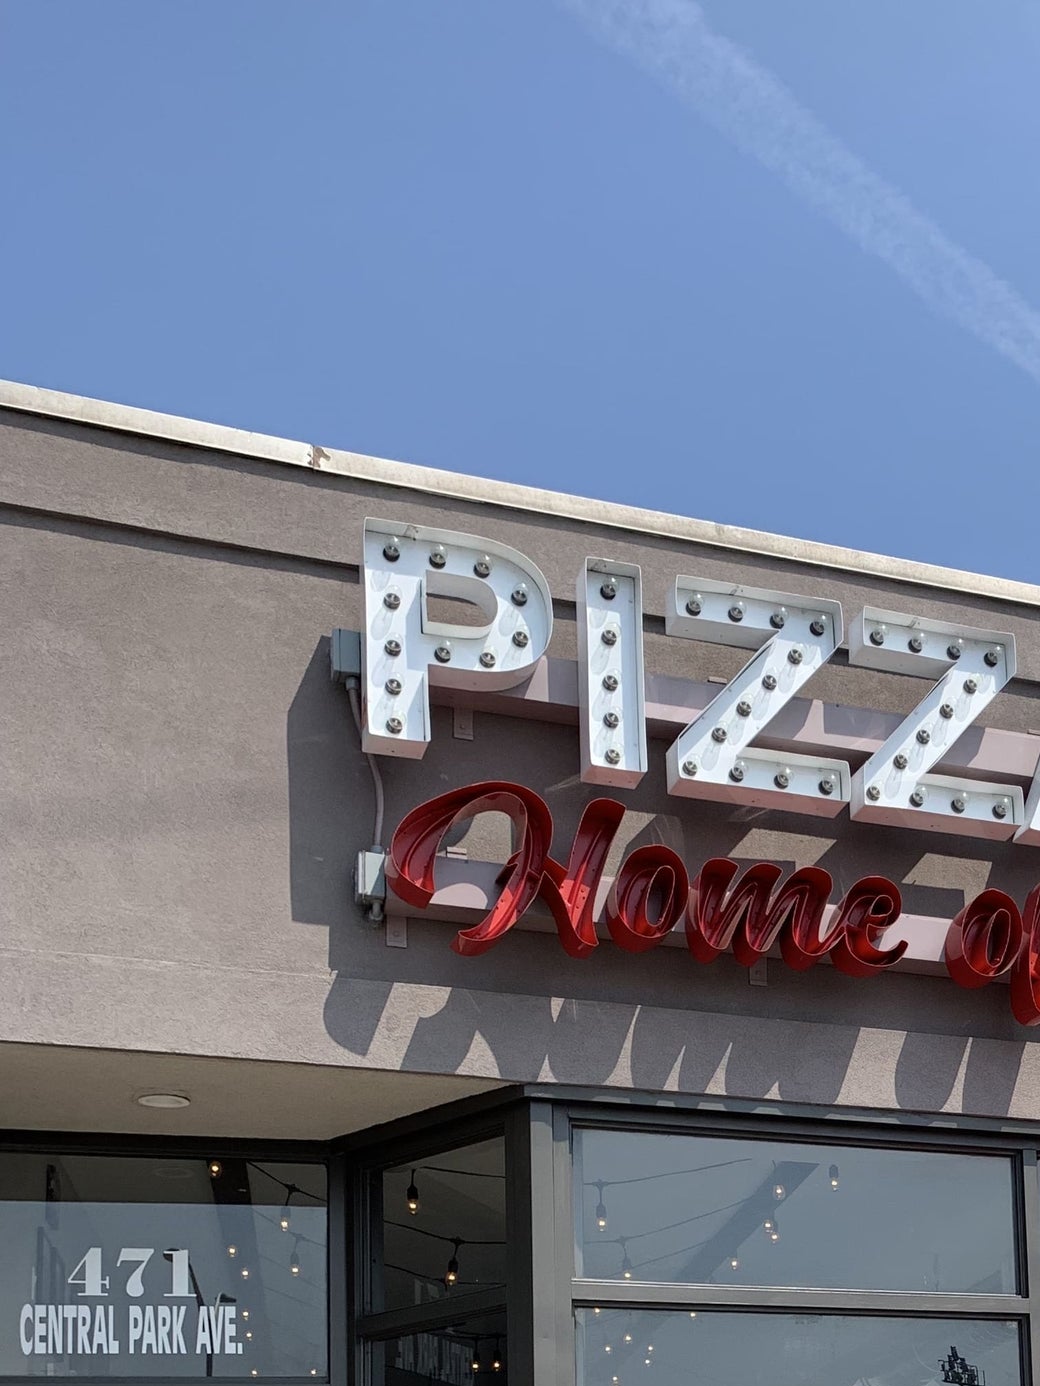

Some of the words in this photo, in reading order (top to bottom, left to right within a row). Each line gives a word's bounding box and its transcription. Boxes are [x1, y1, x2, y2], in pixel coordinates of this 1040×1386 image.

[386, 781, 908, 979] Home
[68, 1247, 197, 1298] 471
[20, 1303, 119, 1355] CENTRAL
[129, 1305, 187, 1354] PARK
[196, 1305, 243, 1354] AVE.
